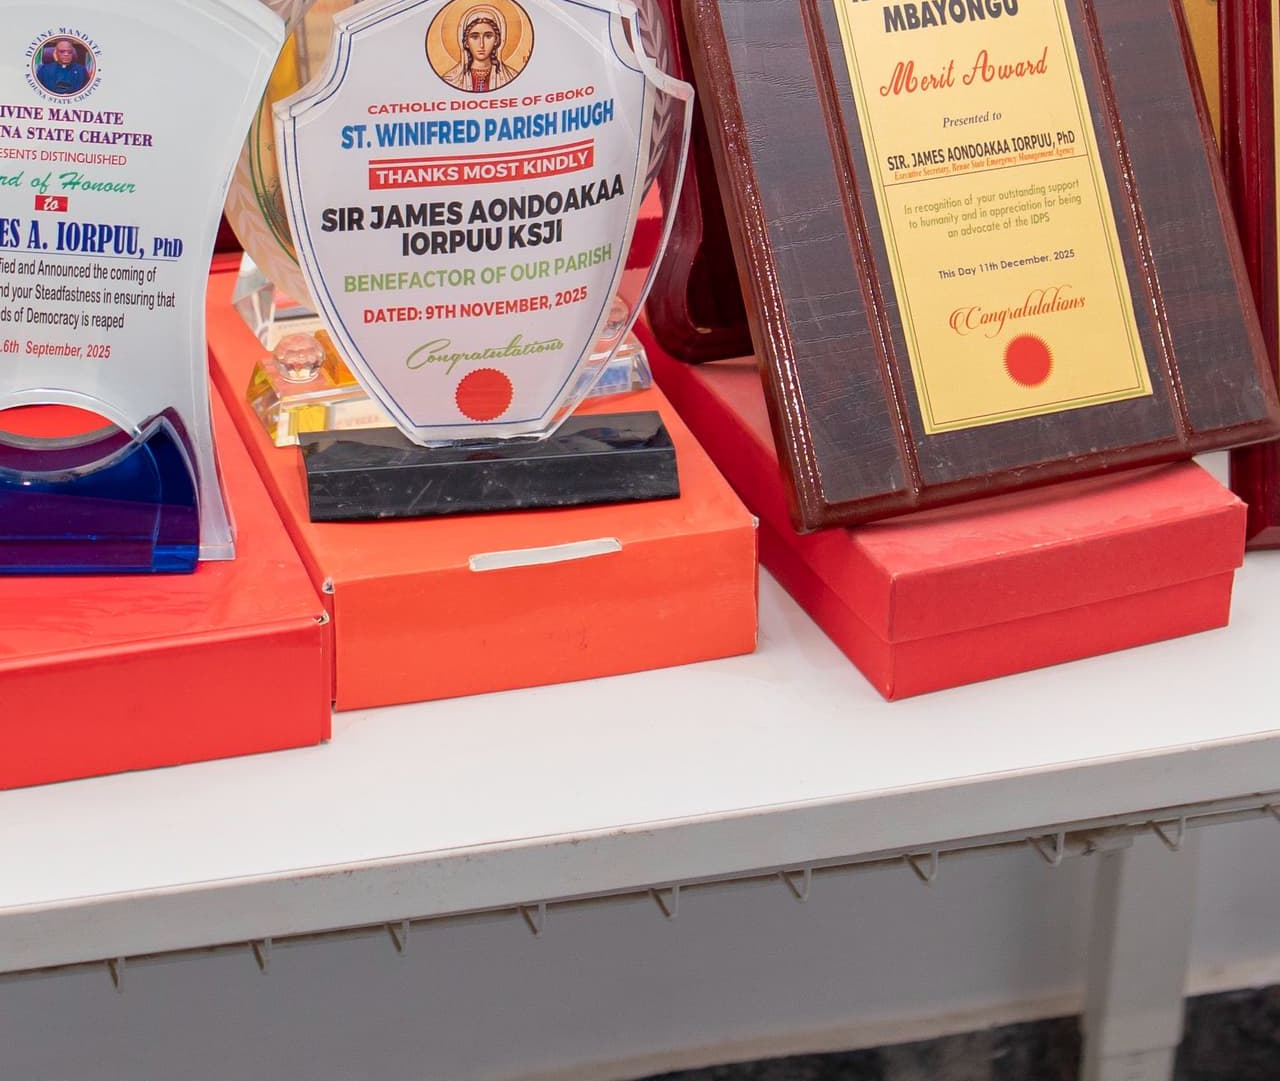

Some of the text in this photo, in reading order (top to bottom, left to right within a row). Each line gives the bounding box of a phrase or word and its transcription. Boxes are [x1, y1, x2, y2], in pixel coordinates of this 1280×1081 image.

[879, 46, 1049, 97] Merit Award
[47, 108, 124, 125] MANDATE
[367, 86, 595, 115] CATHOLIC DIOCESE OF GBOKO
[26, 126, 74, 142] STATE
[79, 130, 153, 147] CHAPTER
[341, 98, 614, 149] ST. WINIFRED PARISH IHUGH
[942, 111, 1002, 128] Presented to
[40, 150, 127, 166] DISTINGUISHED
[887, 130, 1075, 171] SIR. JAMES AONDOAKAA IORPUU, PhD
[30, 172, 53, 195] of
[58, 171, 136, 194] Honour
[376, 151, 589, 186] THANKS MOST KINDLY
[42, 196, 60, 211] to
[321, 174, 625, 233] SIR JAMES AONDOAKAA
[26, 220, 48, 250] A.
[55, 221, 145, 260] IORPUU,
[153, 237, 183, 258] PhD
[401, 219, 563, 256] IORPUU KSJI
[344, 243, 612, 294] BENEFACTOR OF OUR PARISH
[938, 269, 956, 281] This
[958, 266, 977, 278] Day
[979, 262, 999, 273] 11th
[1054, 249, 1075, 261] 2025
[14, 306, 25, 323] of
[26, 307, 79, 330] Democracy
[81, 310, 90, 326] is
[91, 312, 125, 335] reaped
[363, 286, 588, 324] DATED: 9TH NOVEMBER, 2025
[949, 284, 1086, 339] Congratulations
[25, 340, 83, 360] September,
[86, 343, 112, 359] 2025
[405, 334, 565, 376] Congratulations
